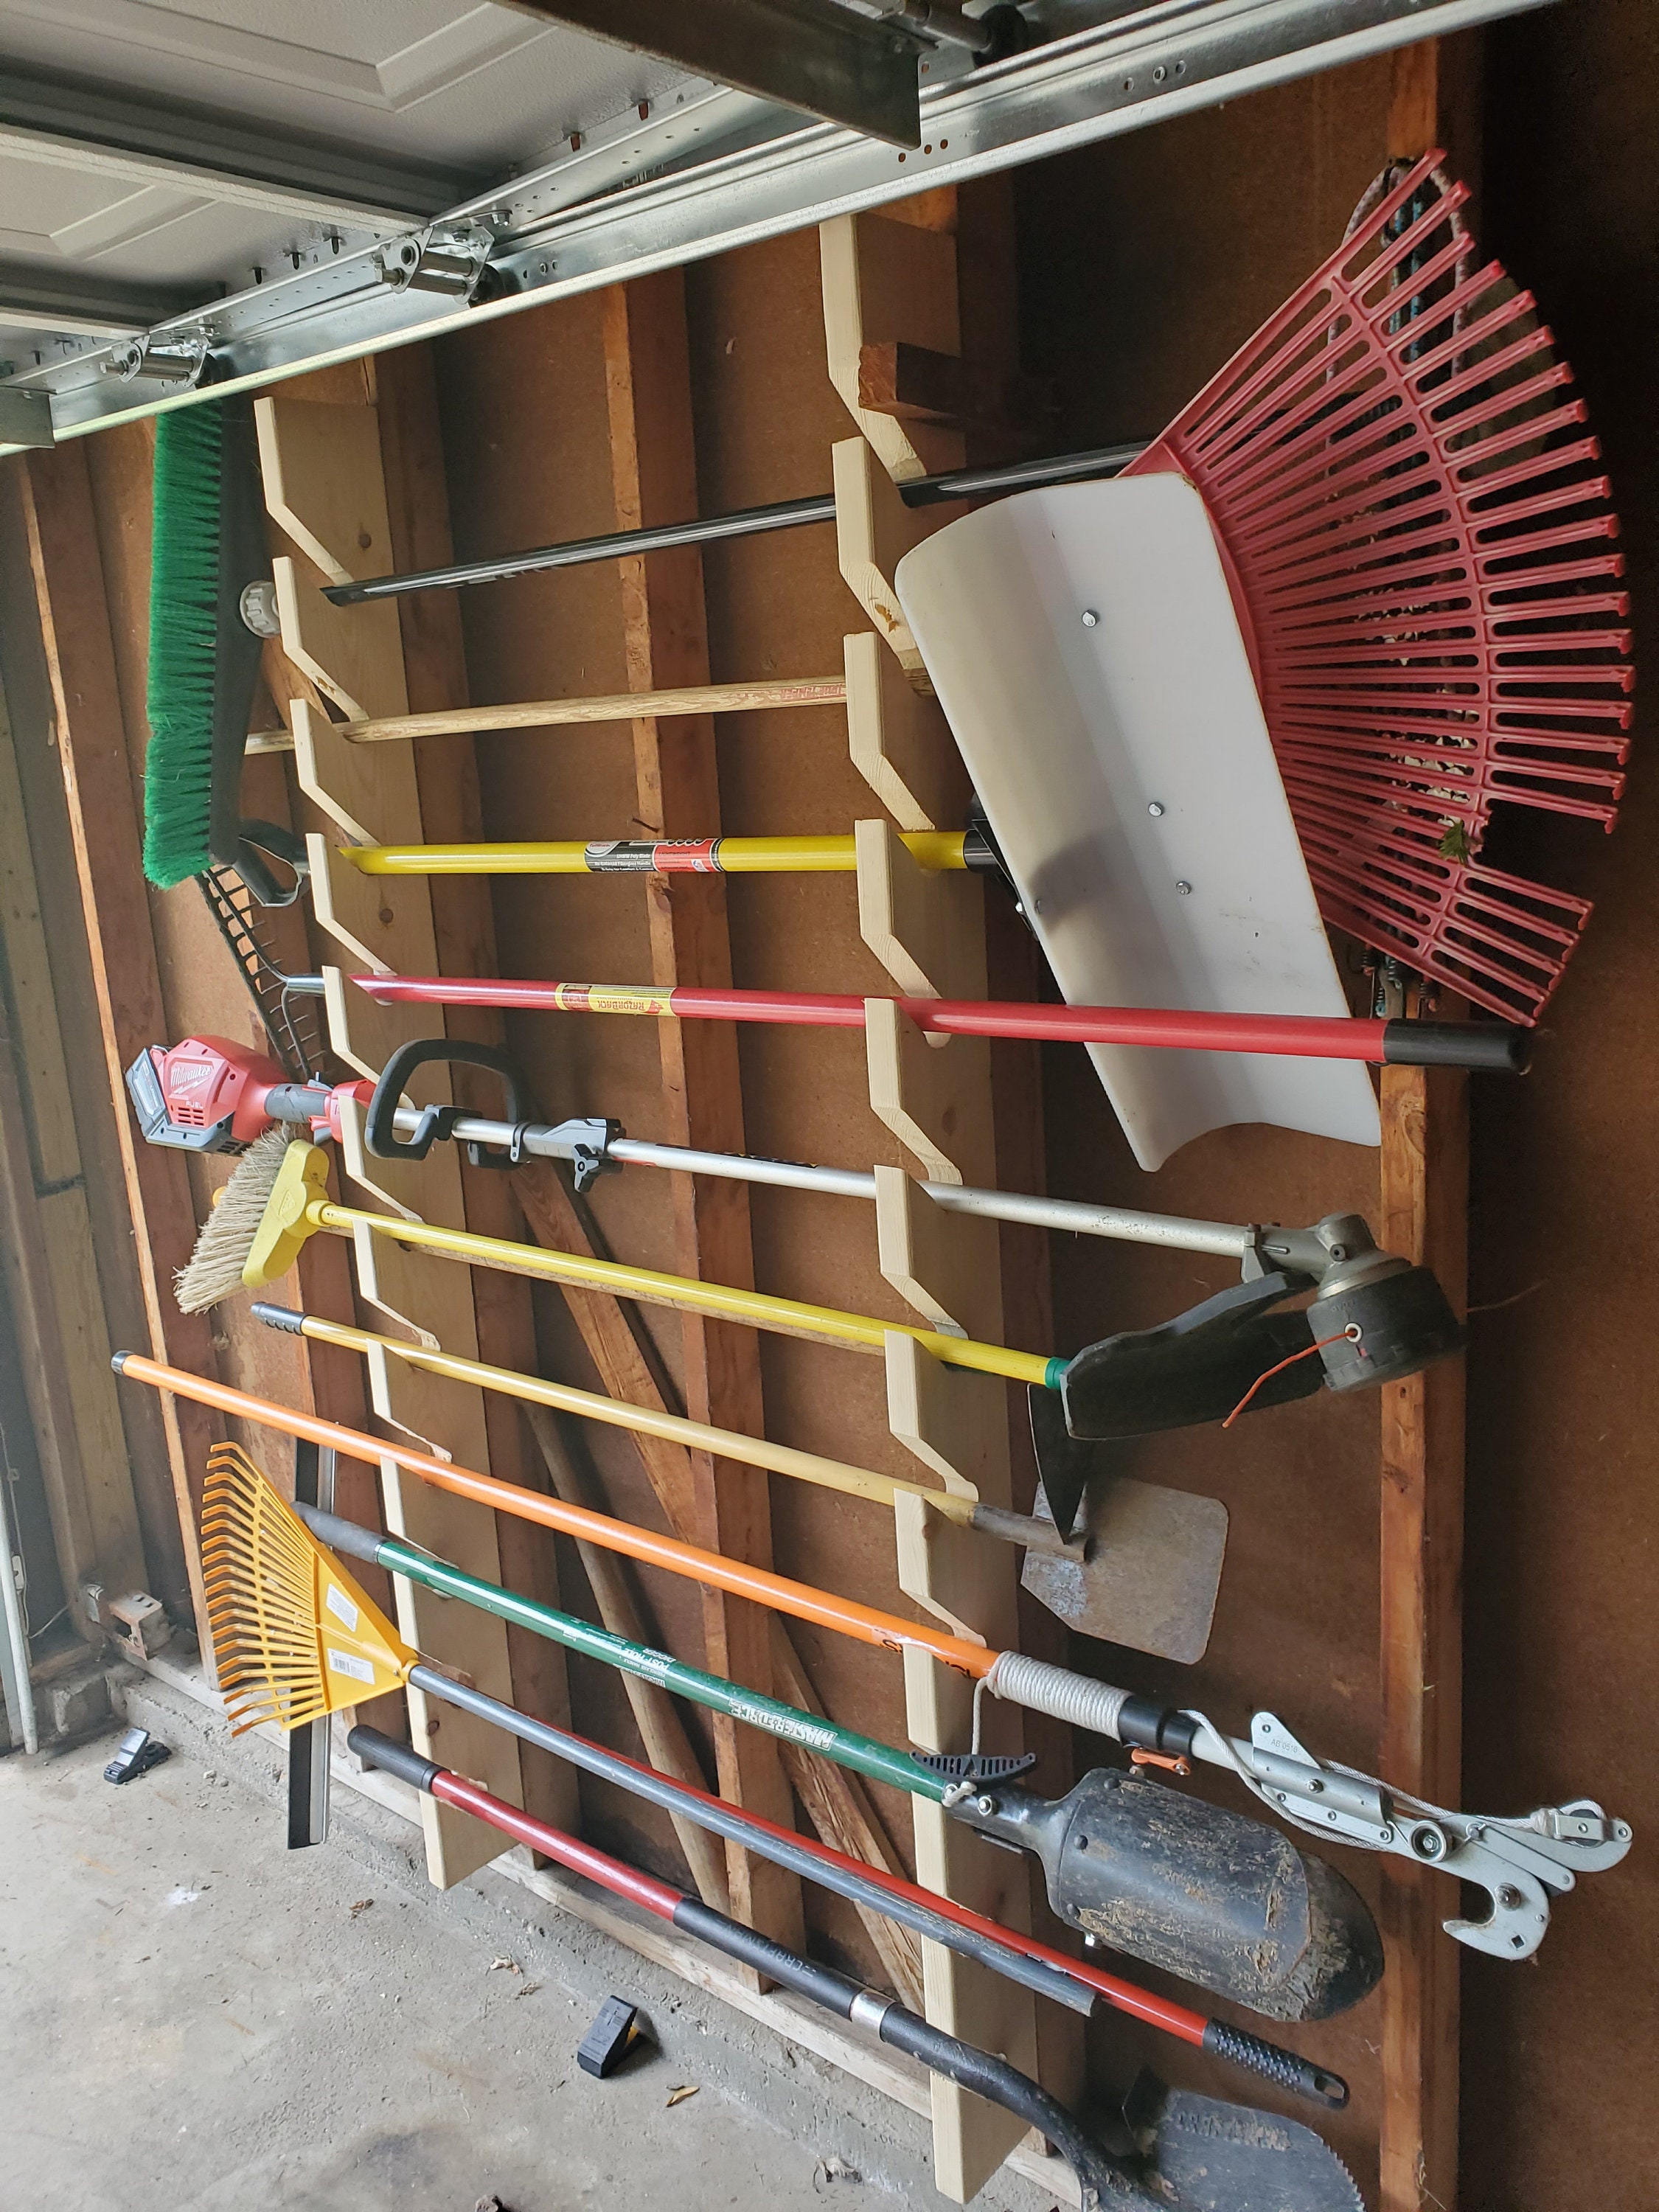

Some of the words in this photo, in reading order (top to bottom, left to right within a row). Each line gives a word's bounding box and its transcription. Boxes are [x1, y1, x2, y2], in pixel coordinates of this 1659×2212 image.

[171, 1065, 212, 1088] Milwaukee
[642, 1648, 676, 1663] DIGGER
[1271, 1739, 1280, 1747] AB
